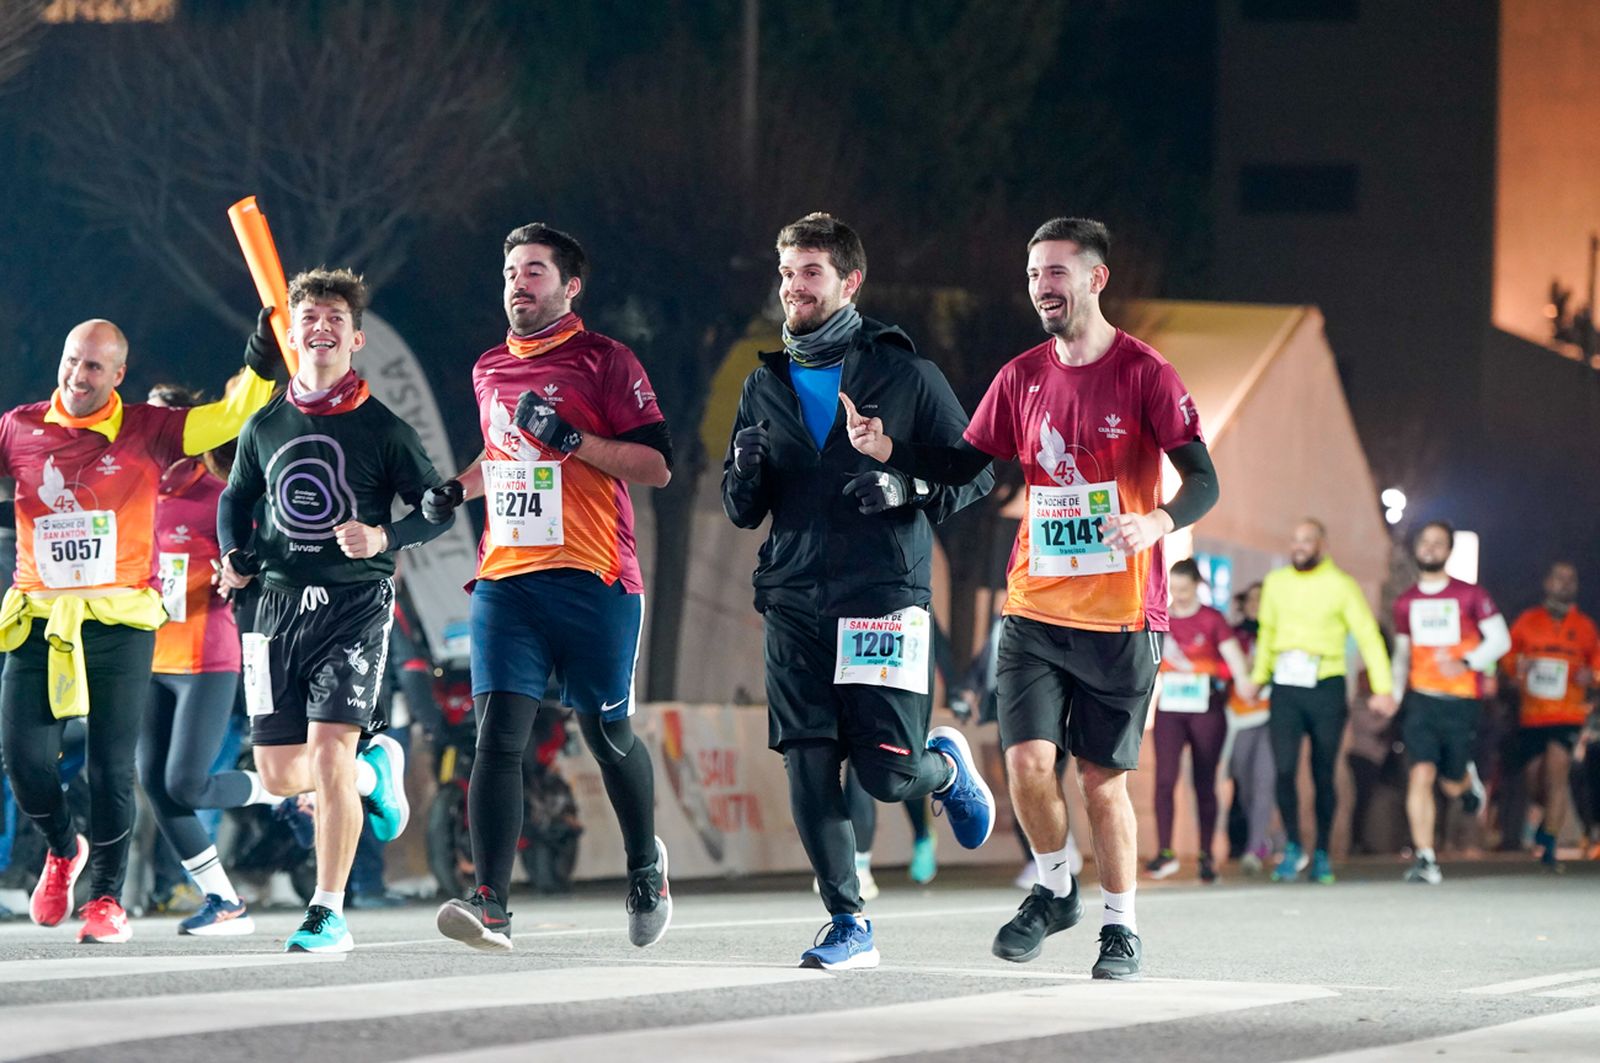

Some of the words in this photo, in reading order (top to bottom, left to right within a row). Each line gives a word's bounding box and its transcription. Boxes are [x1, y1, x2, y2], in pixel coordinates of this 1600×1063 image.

[516, 470, 527, 480] DE
[1053, 460, 1075, 485] 43
[53, 495, 76, 514] 43
[496, 491, 543, 518] 5274
[1044, 497, 1067, 507] NOCHE
[1068, 496, 1080, 506] DE
[1036, 509, 1051, 518] SAN
[1051, 506, 1082, 518] ANTÓN
[52, 521, 75, 529] NOCHE
[76, 520, 85, 528] DE
[43, 531, 59, 540] SAN
[1041, 517, 1105, 546] 12141
[51, 538, 101, 562] 5057
[849, 620, 869, 630] SAN
[869, 621, 903, 631] ANTÓN
